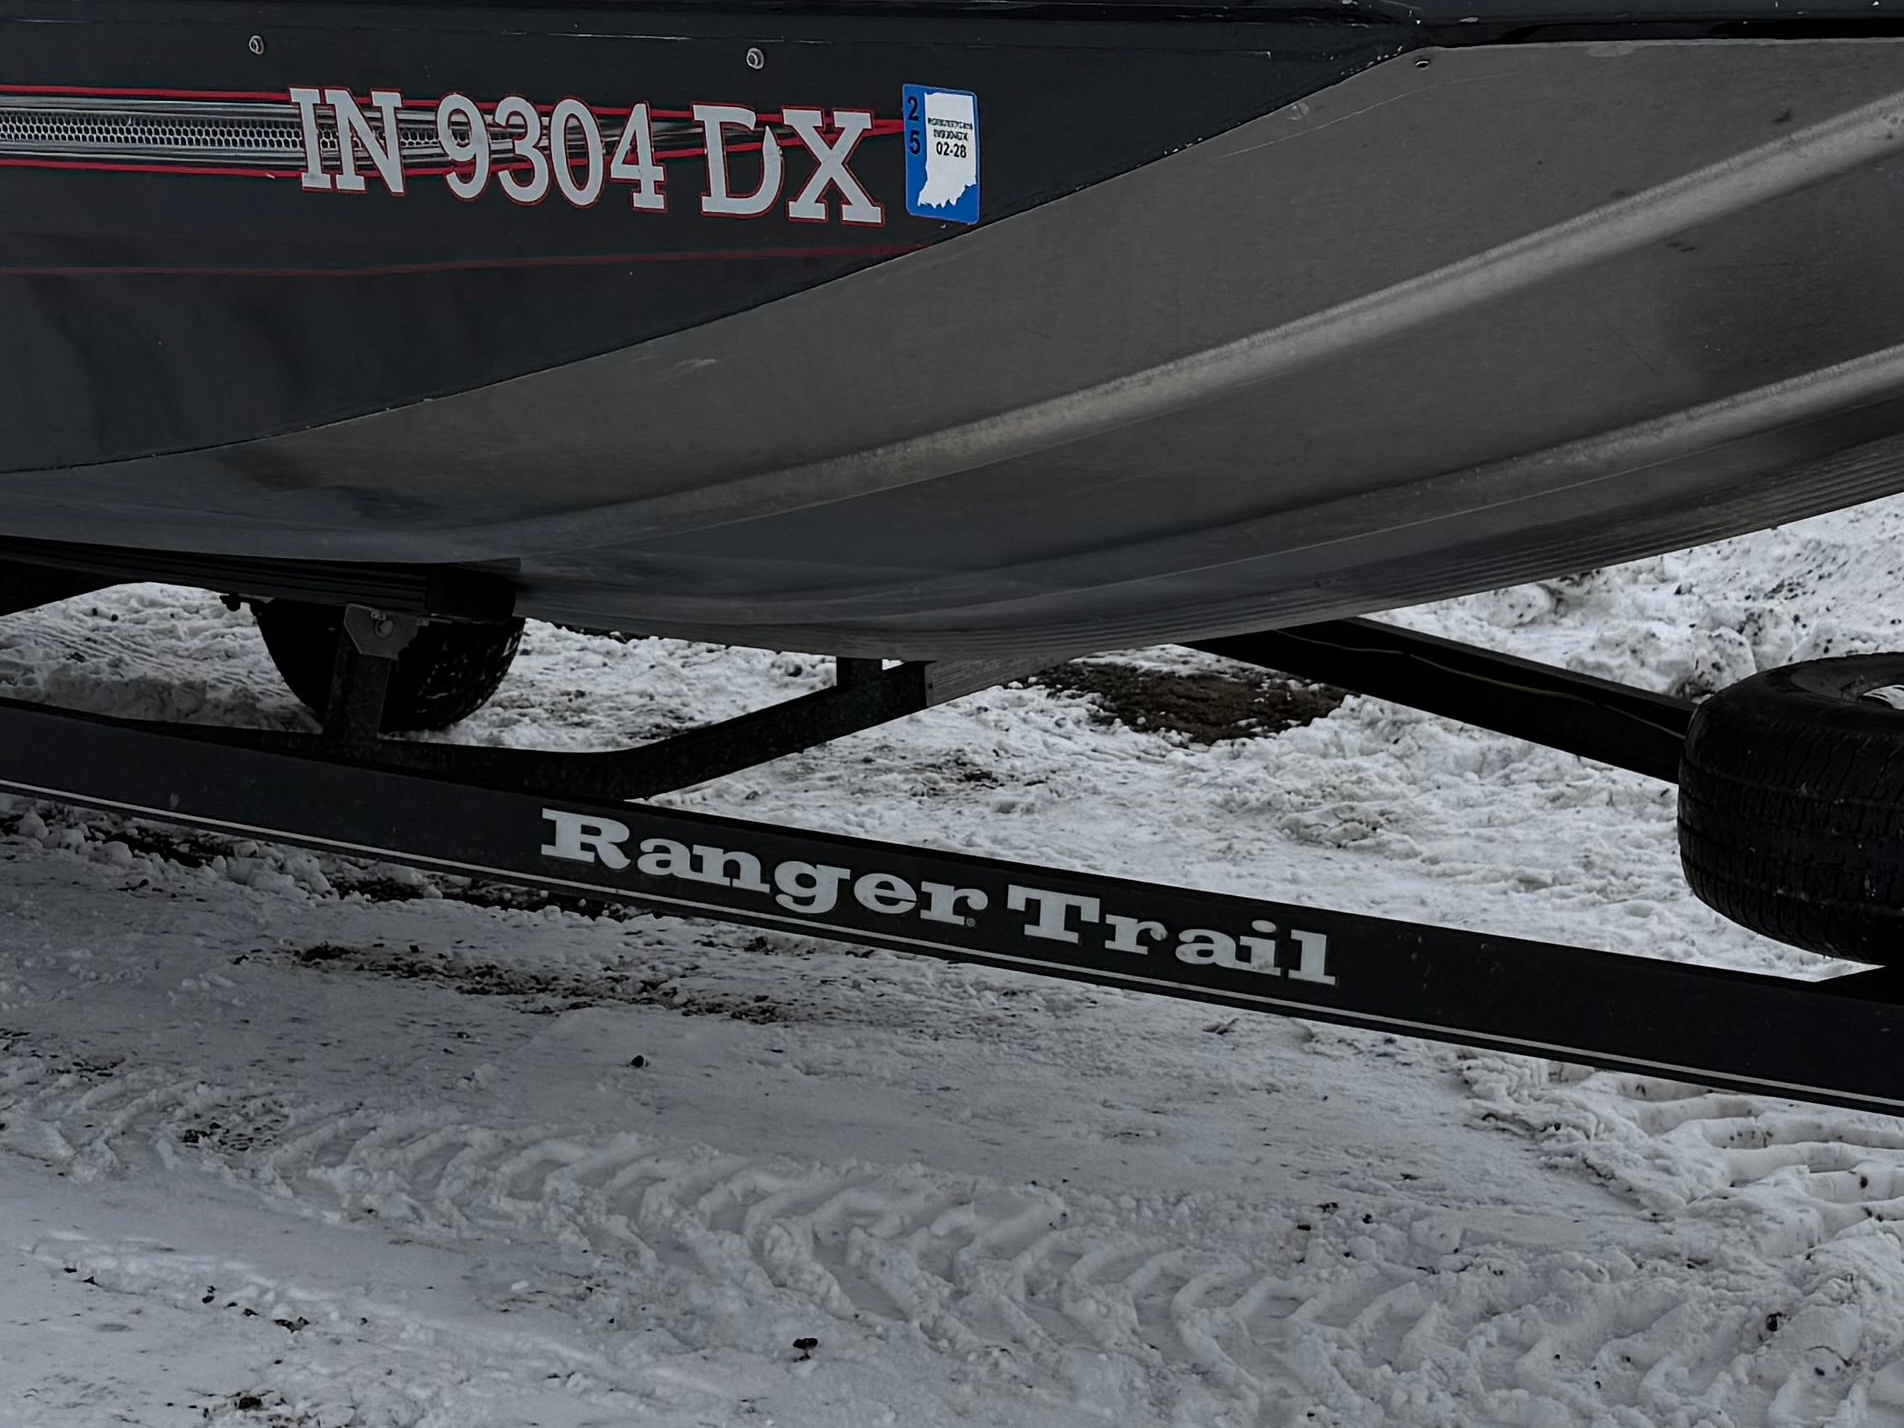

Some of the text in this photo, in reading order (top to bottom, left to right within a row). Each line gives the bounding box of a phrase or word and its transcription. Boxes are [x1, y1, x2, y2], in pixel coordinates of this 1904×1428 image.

[289, 87, 884, 224] IN 9304 DX
[540, 807, 1338, 987] Ranger Trail
